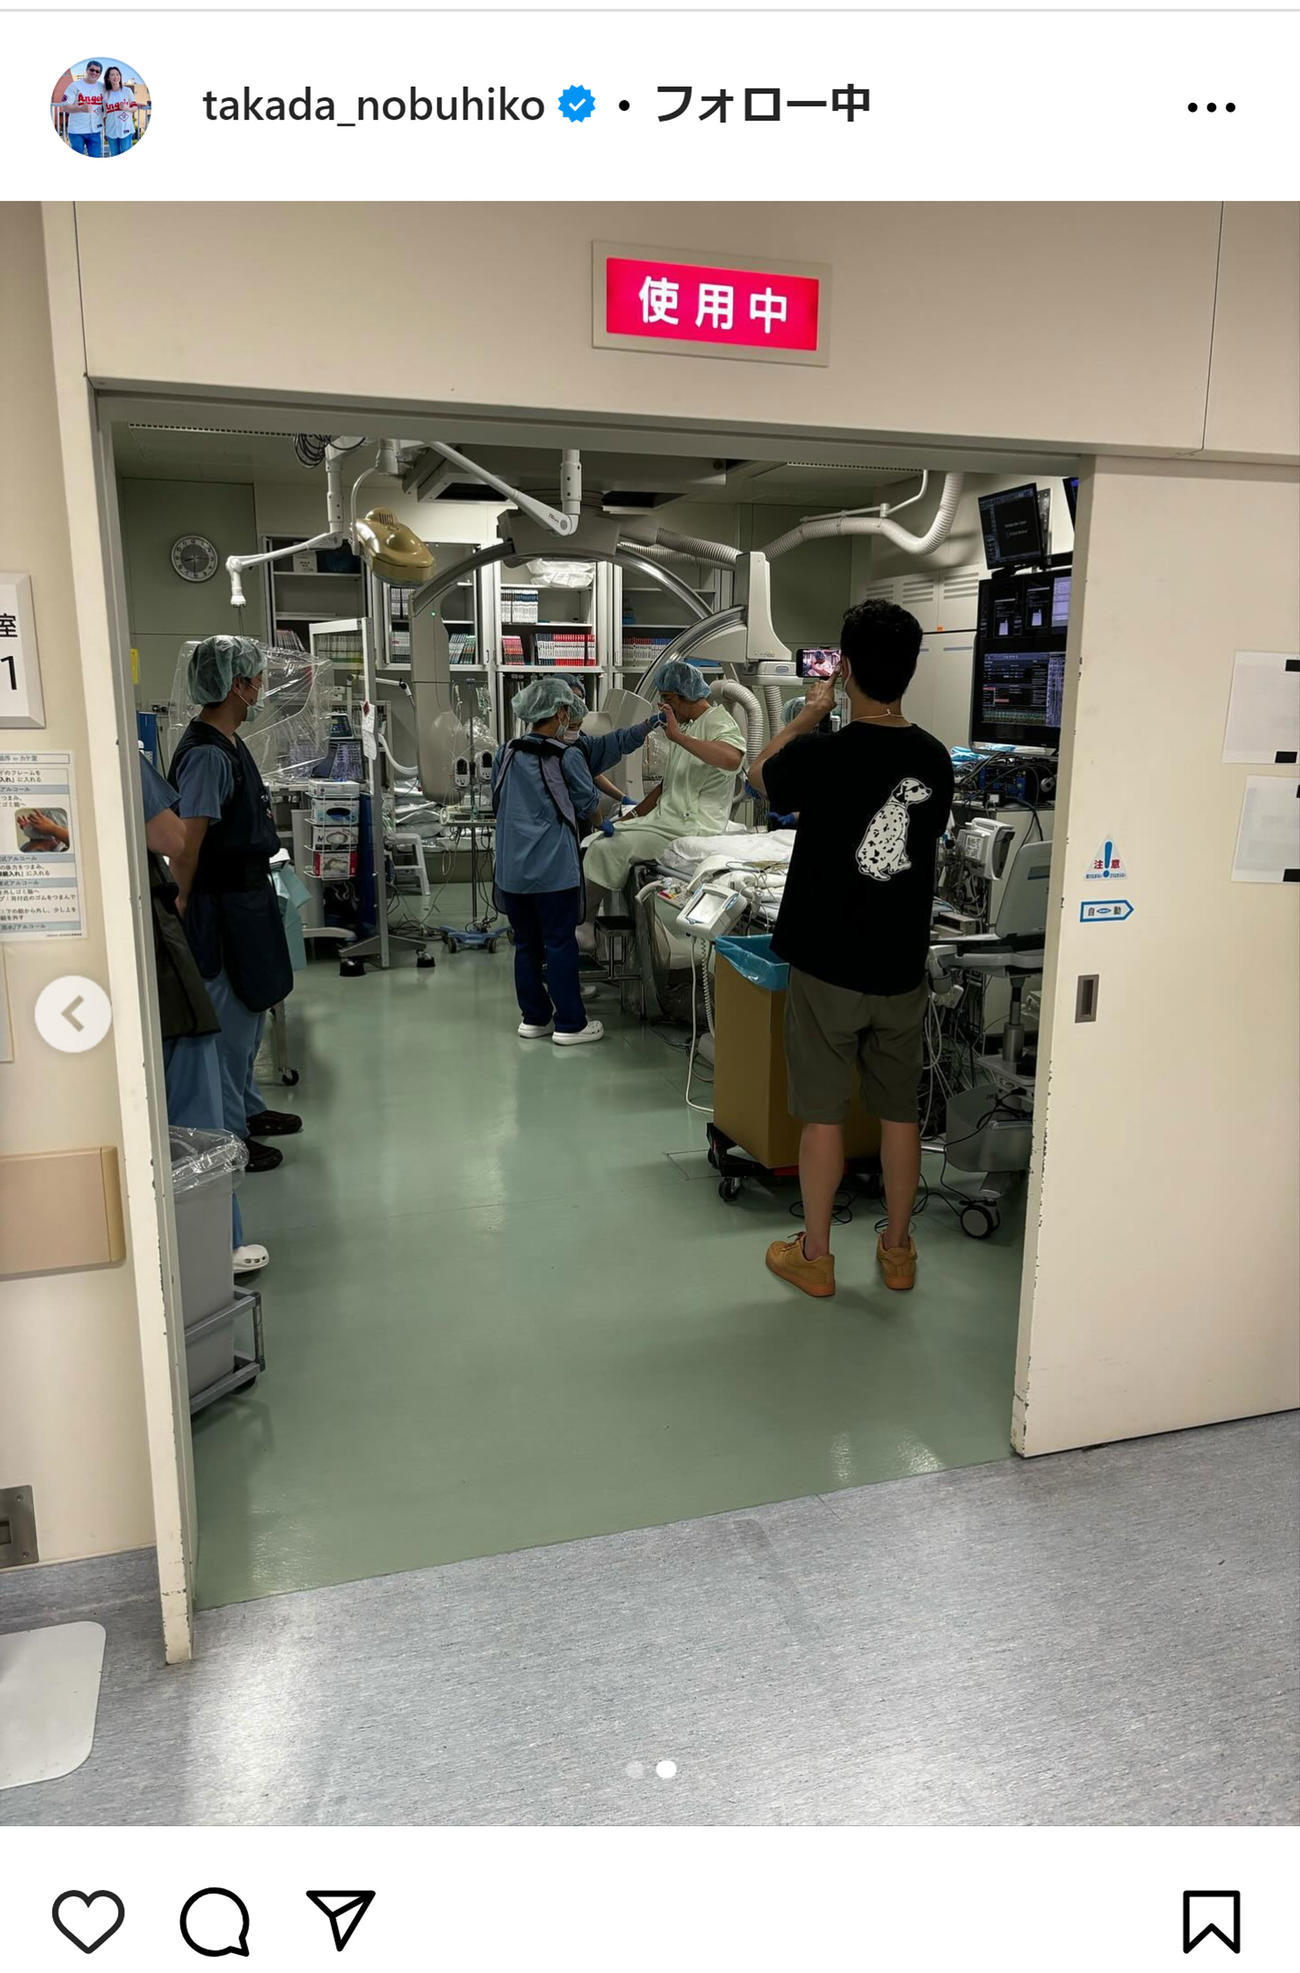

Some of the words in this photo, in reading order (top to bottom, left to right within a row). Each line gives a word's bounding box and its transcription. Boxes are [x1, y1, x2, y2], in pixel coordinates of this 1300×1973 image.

[638, 275, 788, 335] 使用中
[0, 613, 18, 638] 室
[1, 655, 17, 691] 1
